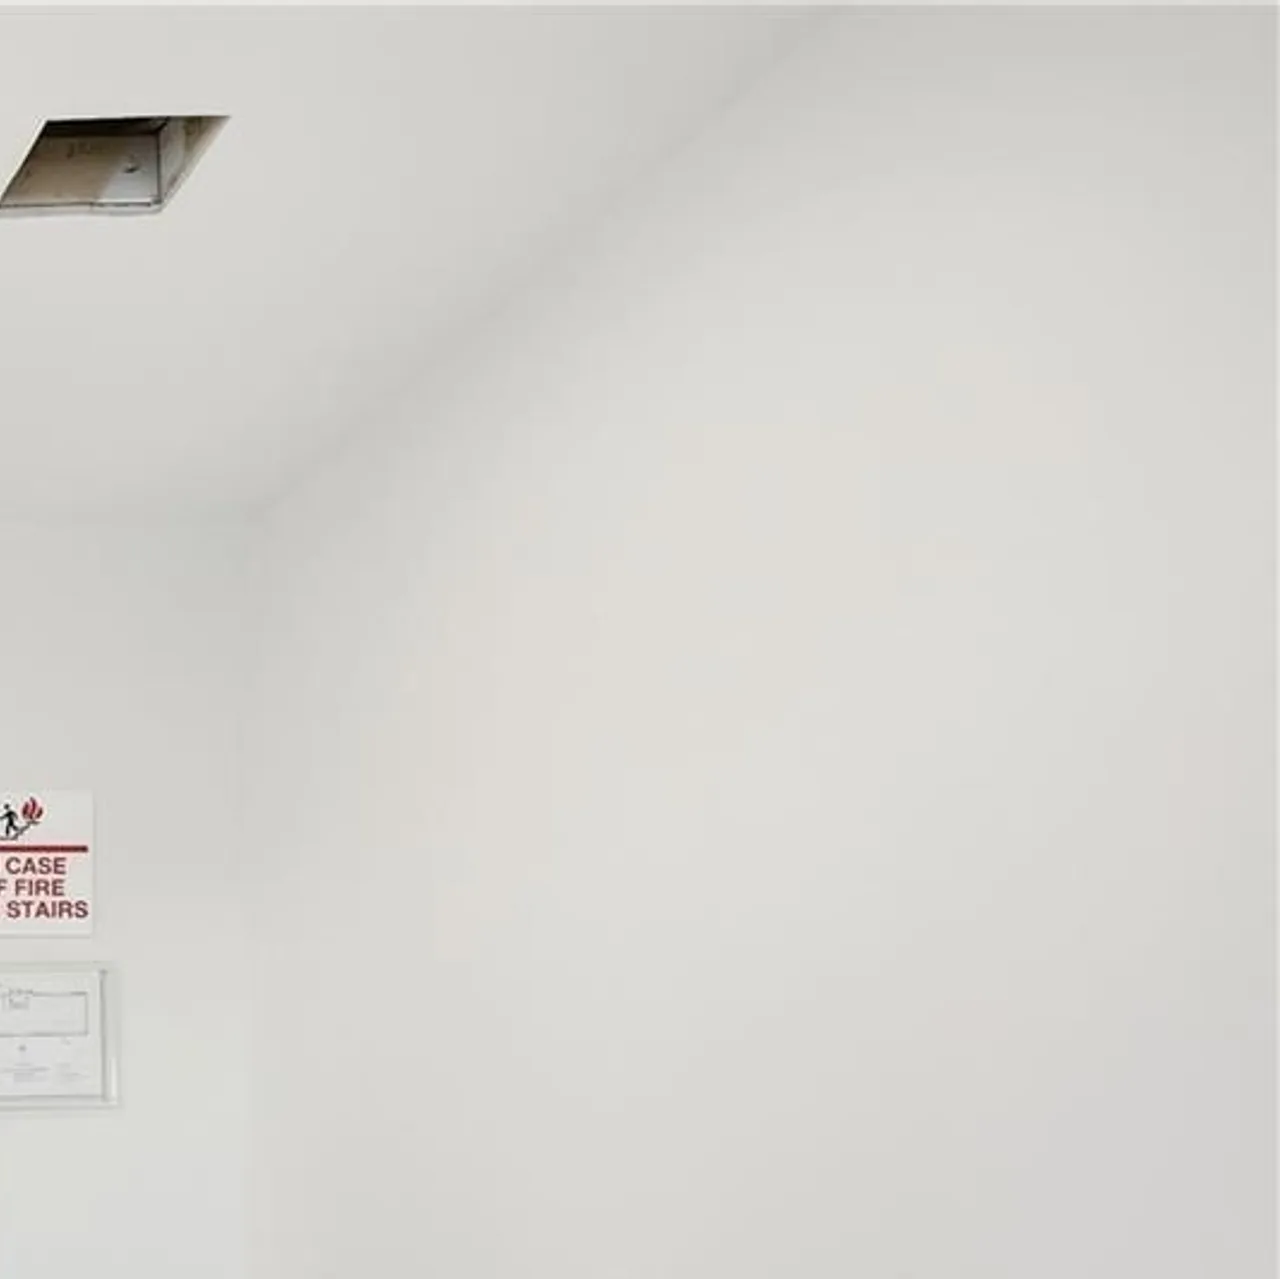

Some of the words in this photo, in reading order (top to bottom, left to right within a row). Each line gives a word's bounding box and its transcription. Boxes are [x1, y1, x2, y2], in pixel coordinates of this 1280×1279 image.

[5, 857, 67, 875] CASE
[14, 879, 65, 897] FIRE
[6, 900, 89, 918] STAIRS
